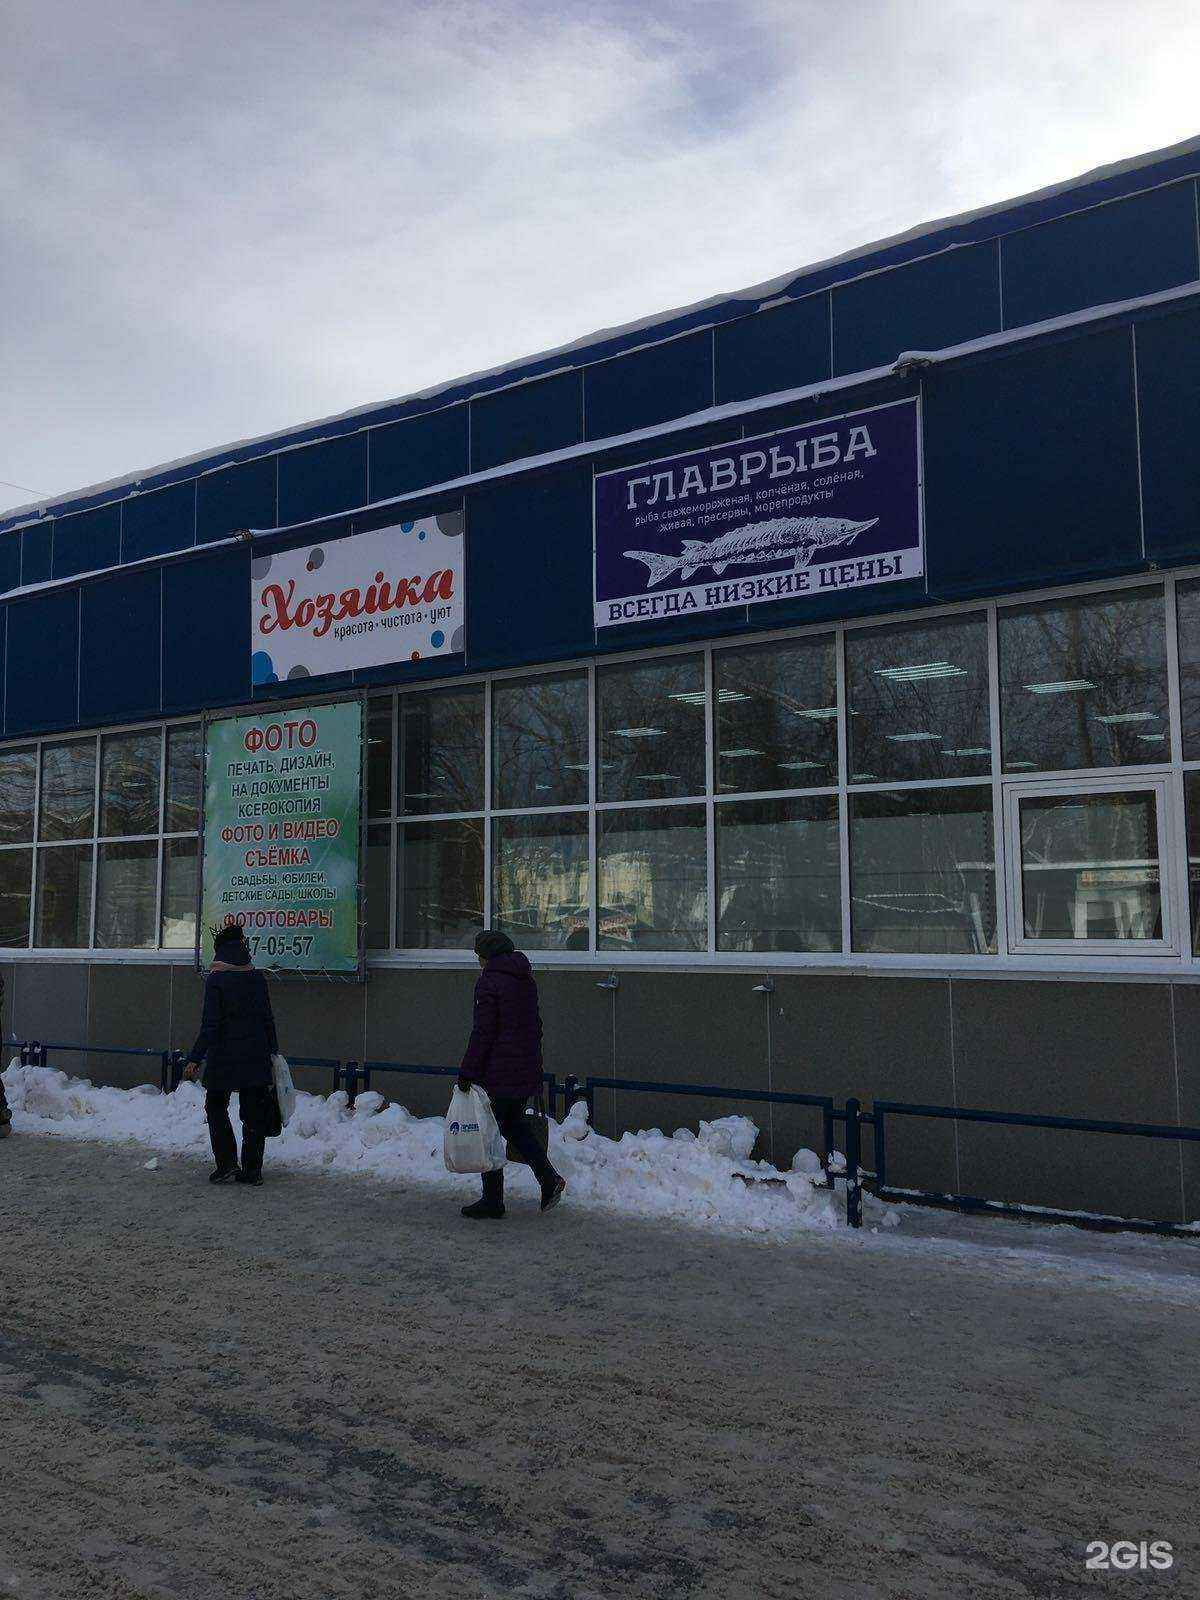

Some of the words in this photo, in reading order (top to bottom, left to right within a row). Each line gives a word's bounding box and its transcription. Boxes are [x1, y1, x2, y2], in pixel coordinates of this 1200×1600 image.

[627, 425, 877, 509] ГЛАВРЫБА
[635, 512, 660, 526] рыба
[661, 493, 752, 521] свежемороженая,
[756, 480, 810, 501] копчёная,
[813, 469, 864, 488] солёная,
[658, 518, 695, 533] живая,
[754, 489, 834, 514] морепродукты
[608, 590, 698, 621] ВСЕГДА
[704, 571, 810, 606] НИЗКИЕ
[818, 555, 903, 588] ЦЕНЫ
[259, 569, 454, 637] Хозяйка
[334, 622, 374, 640] красота
[381, 613, 422, 630] чистота
[430, 607, 452, 625] уют
[244, 720, 317, 753] ФОТО
[228, 759, 277, 776] ПЕЧАТЬ,
[280, 751, 336, 773] ДИЗАЙН,
[232, 784, 247, 797] НА
[250, 775, 329, 798] ДОКУМЕНТЫ
[238, 798, 321, 818] КСЕРОКОПИЯ
[221, 824, 264, 843] ФОТО
[268, 823, 279, 840] И
[283, 819, 338, 840] ВИДЕО
[245, 845, 311, 867] СЪЁМКА
[222, 890, 262, 903] ДЕТСКИЕ
[298, 888, 336, 900] ШКОЛЫ
[224, 909, 333, 928] ФОТОТОВАРЫ
